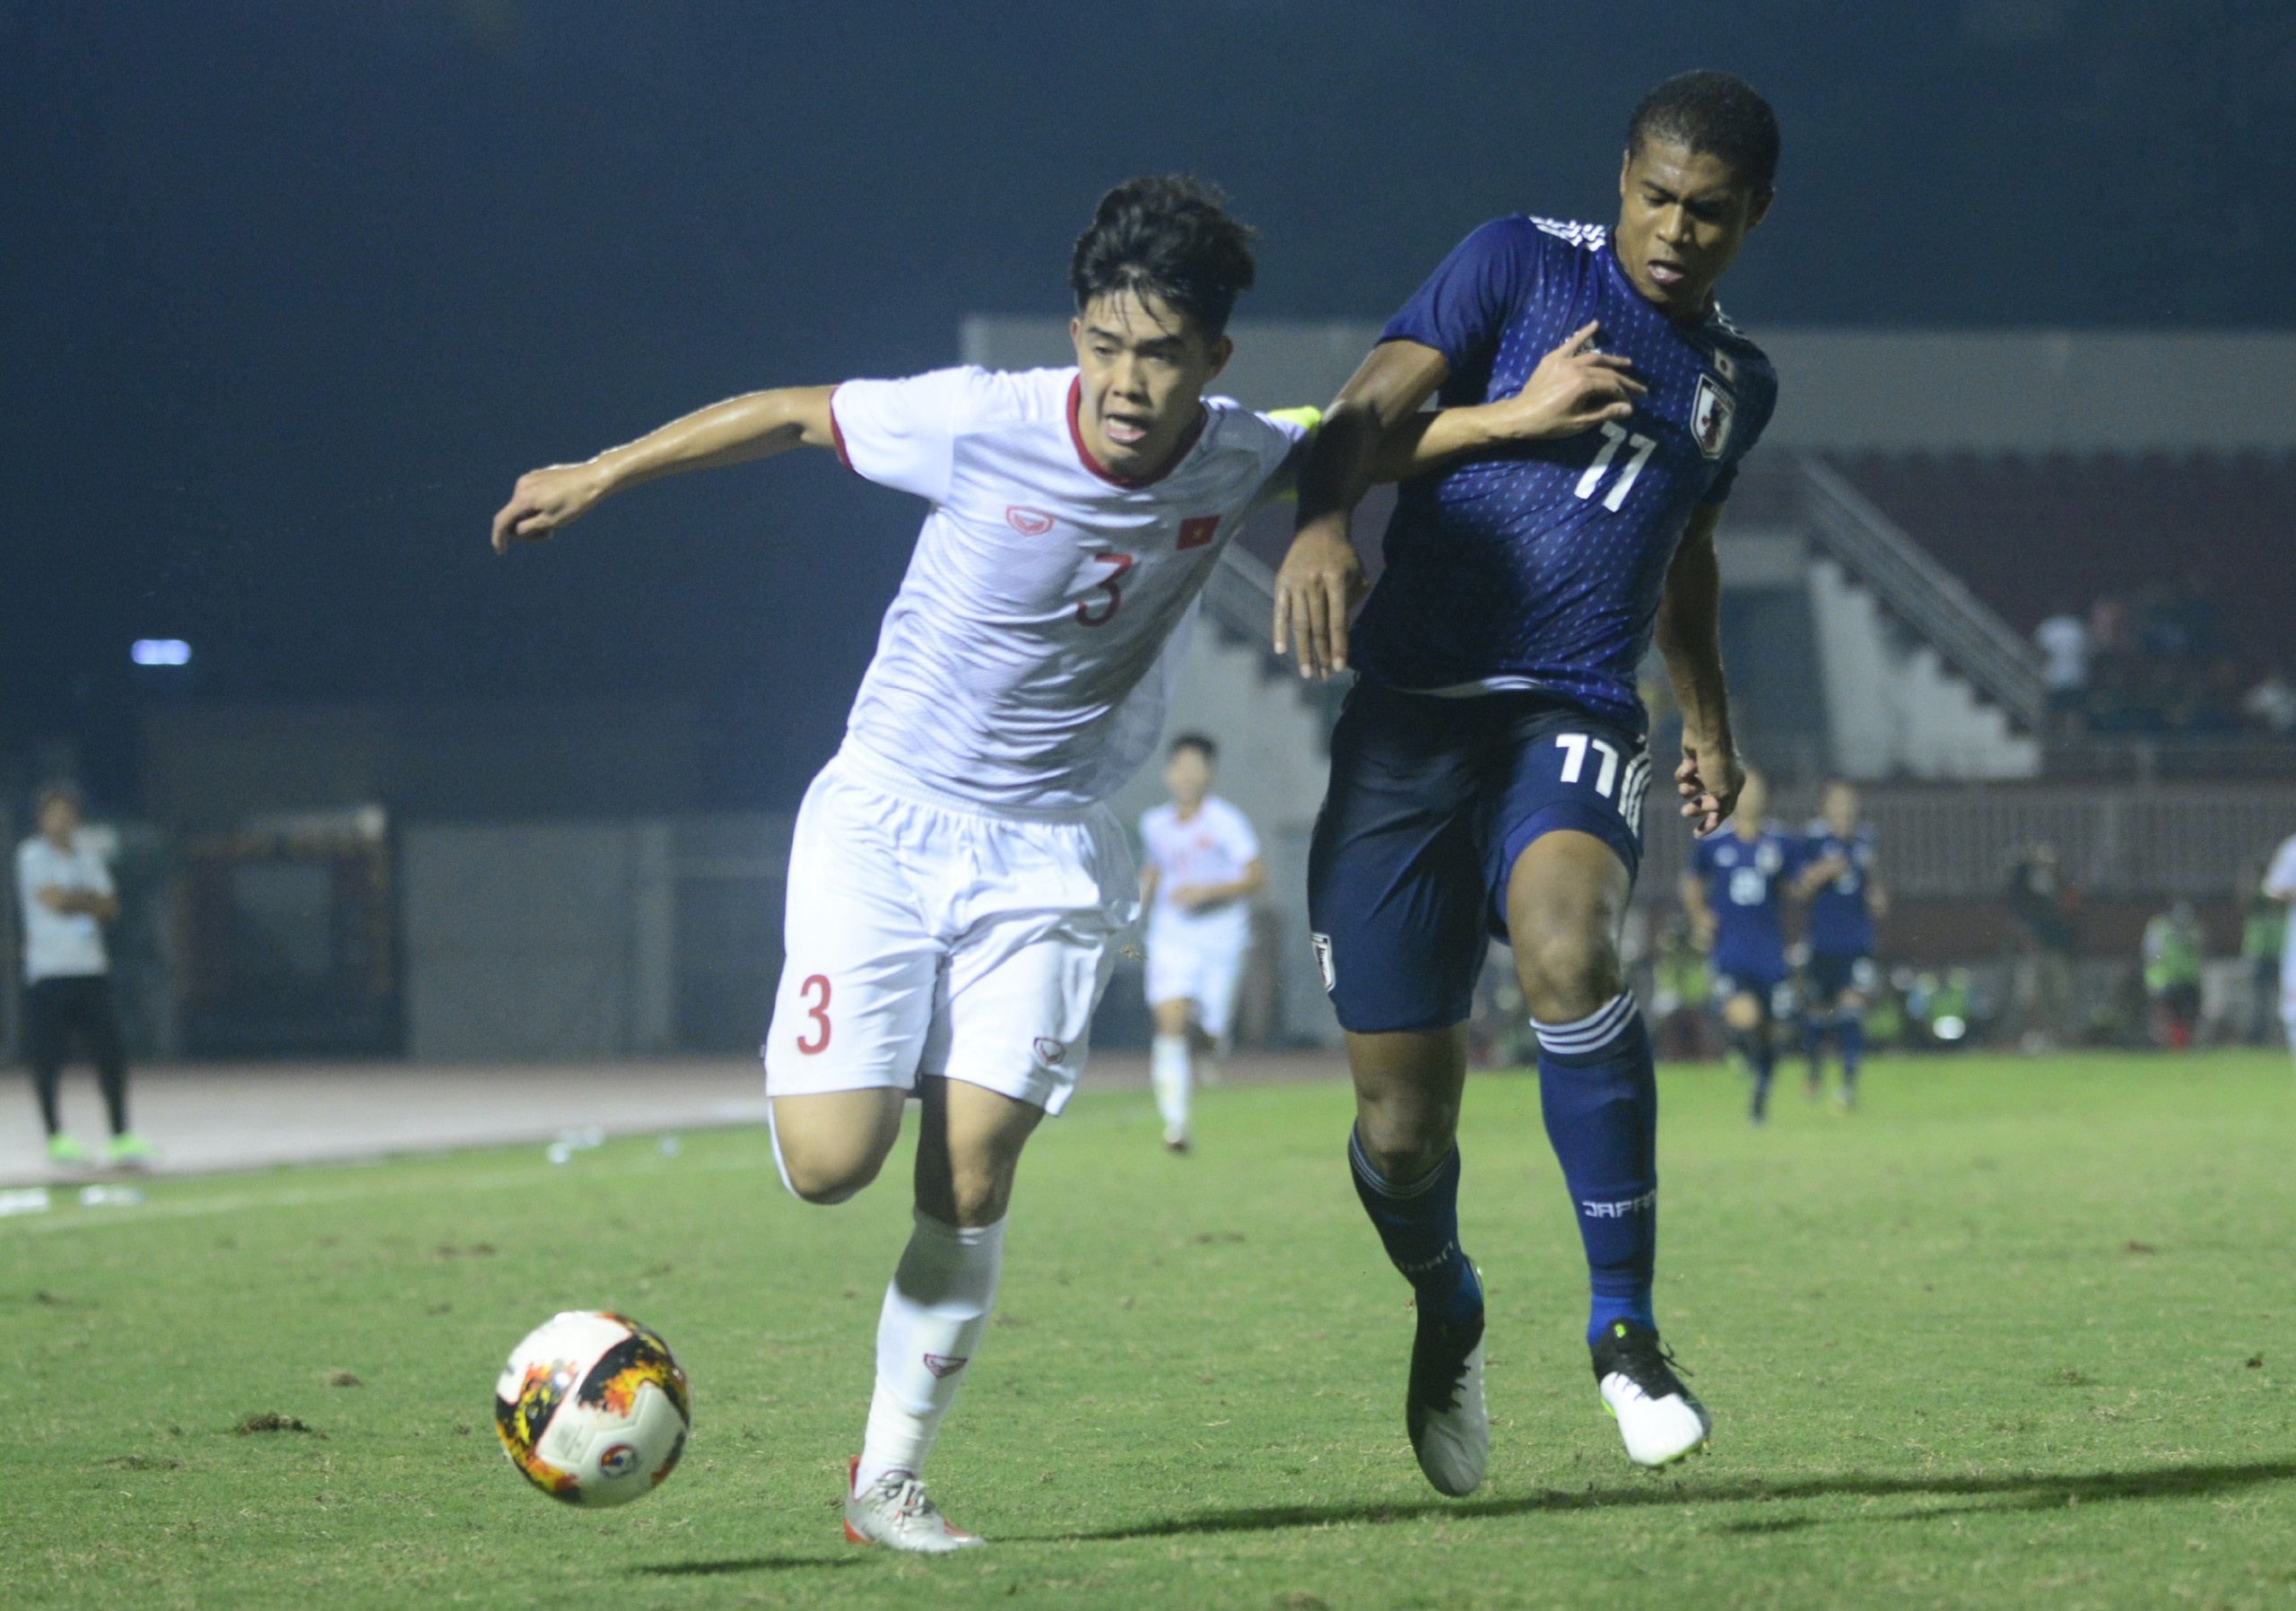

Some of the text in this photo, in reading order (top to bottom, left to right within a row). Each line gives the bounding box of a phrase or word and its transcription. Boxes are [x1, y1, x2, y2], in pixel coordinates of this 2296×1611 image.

[1574, 420, 1657, 513] 11
[1075, 552, 1135, 628] 3
[1555, 733, 1619, 798] 11
[796, 973, 831, 1056] 3
